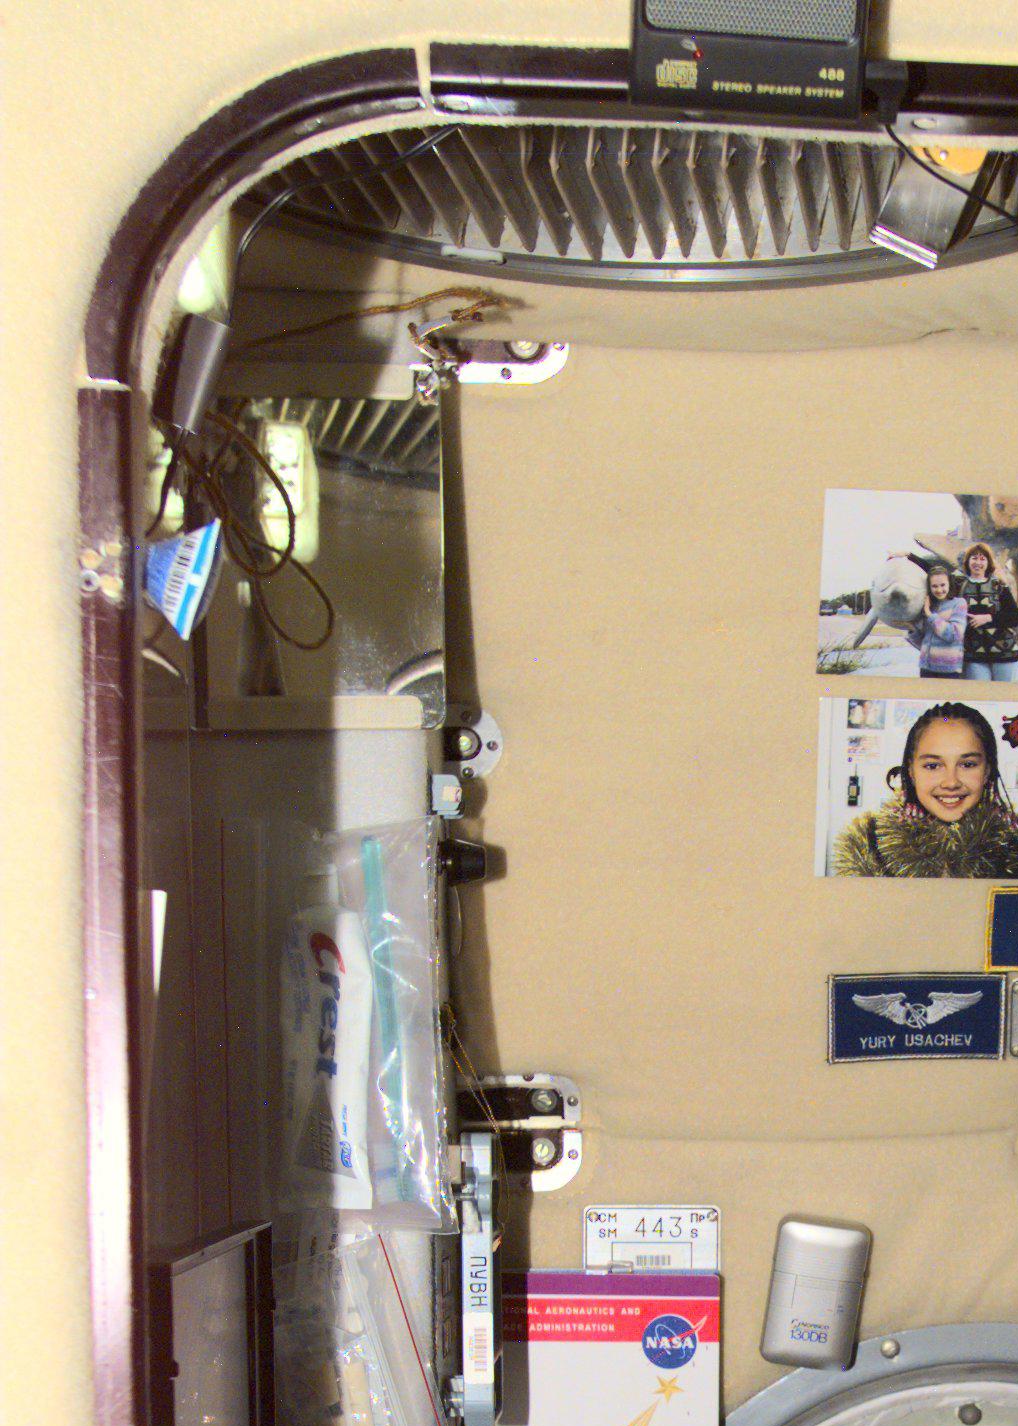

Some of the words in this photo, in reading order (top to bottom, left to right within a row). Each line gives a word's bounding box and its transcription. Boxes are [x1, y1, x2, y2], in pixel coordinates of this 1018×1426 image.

[819, 67, 845, 81] 488
[712, 80, 752, 93] STEREO
[756, 83, 801, 96] SPEAKER
[805, 86, 844, 98] SYSTEM
[309, 932, 345, 1079] Crest
[860, 1035, 895, 1050] YURY
[904, 1034, 972, 1047] USACHEV
[599, 1228, 617, 1238] SM
[690, 1228, 699, 1238] S
[635, 1216, 682, 1238] 443
[545, 1307, 615, 1315] AERONAUTICS
[621, 1307, 641, 1315] AND
[529, 1323, 615, 1332] ADMINISTRATION
[646, 1336, 695, 1349] NASA
